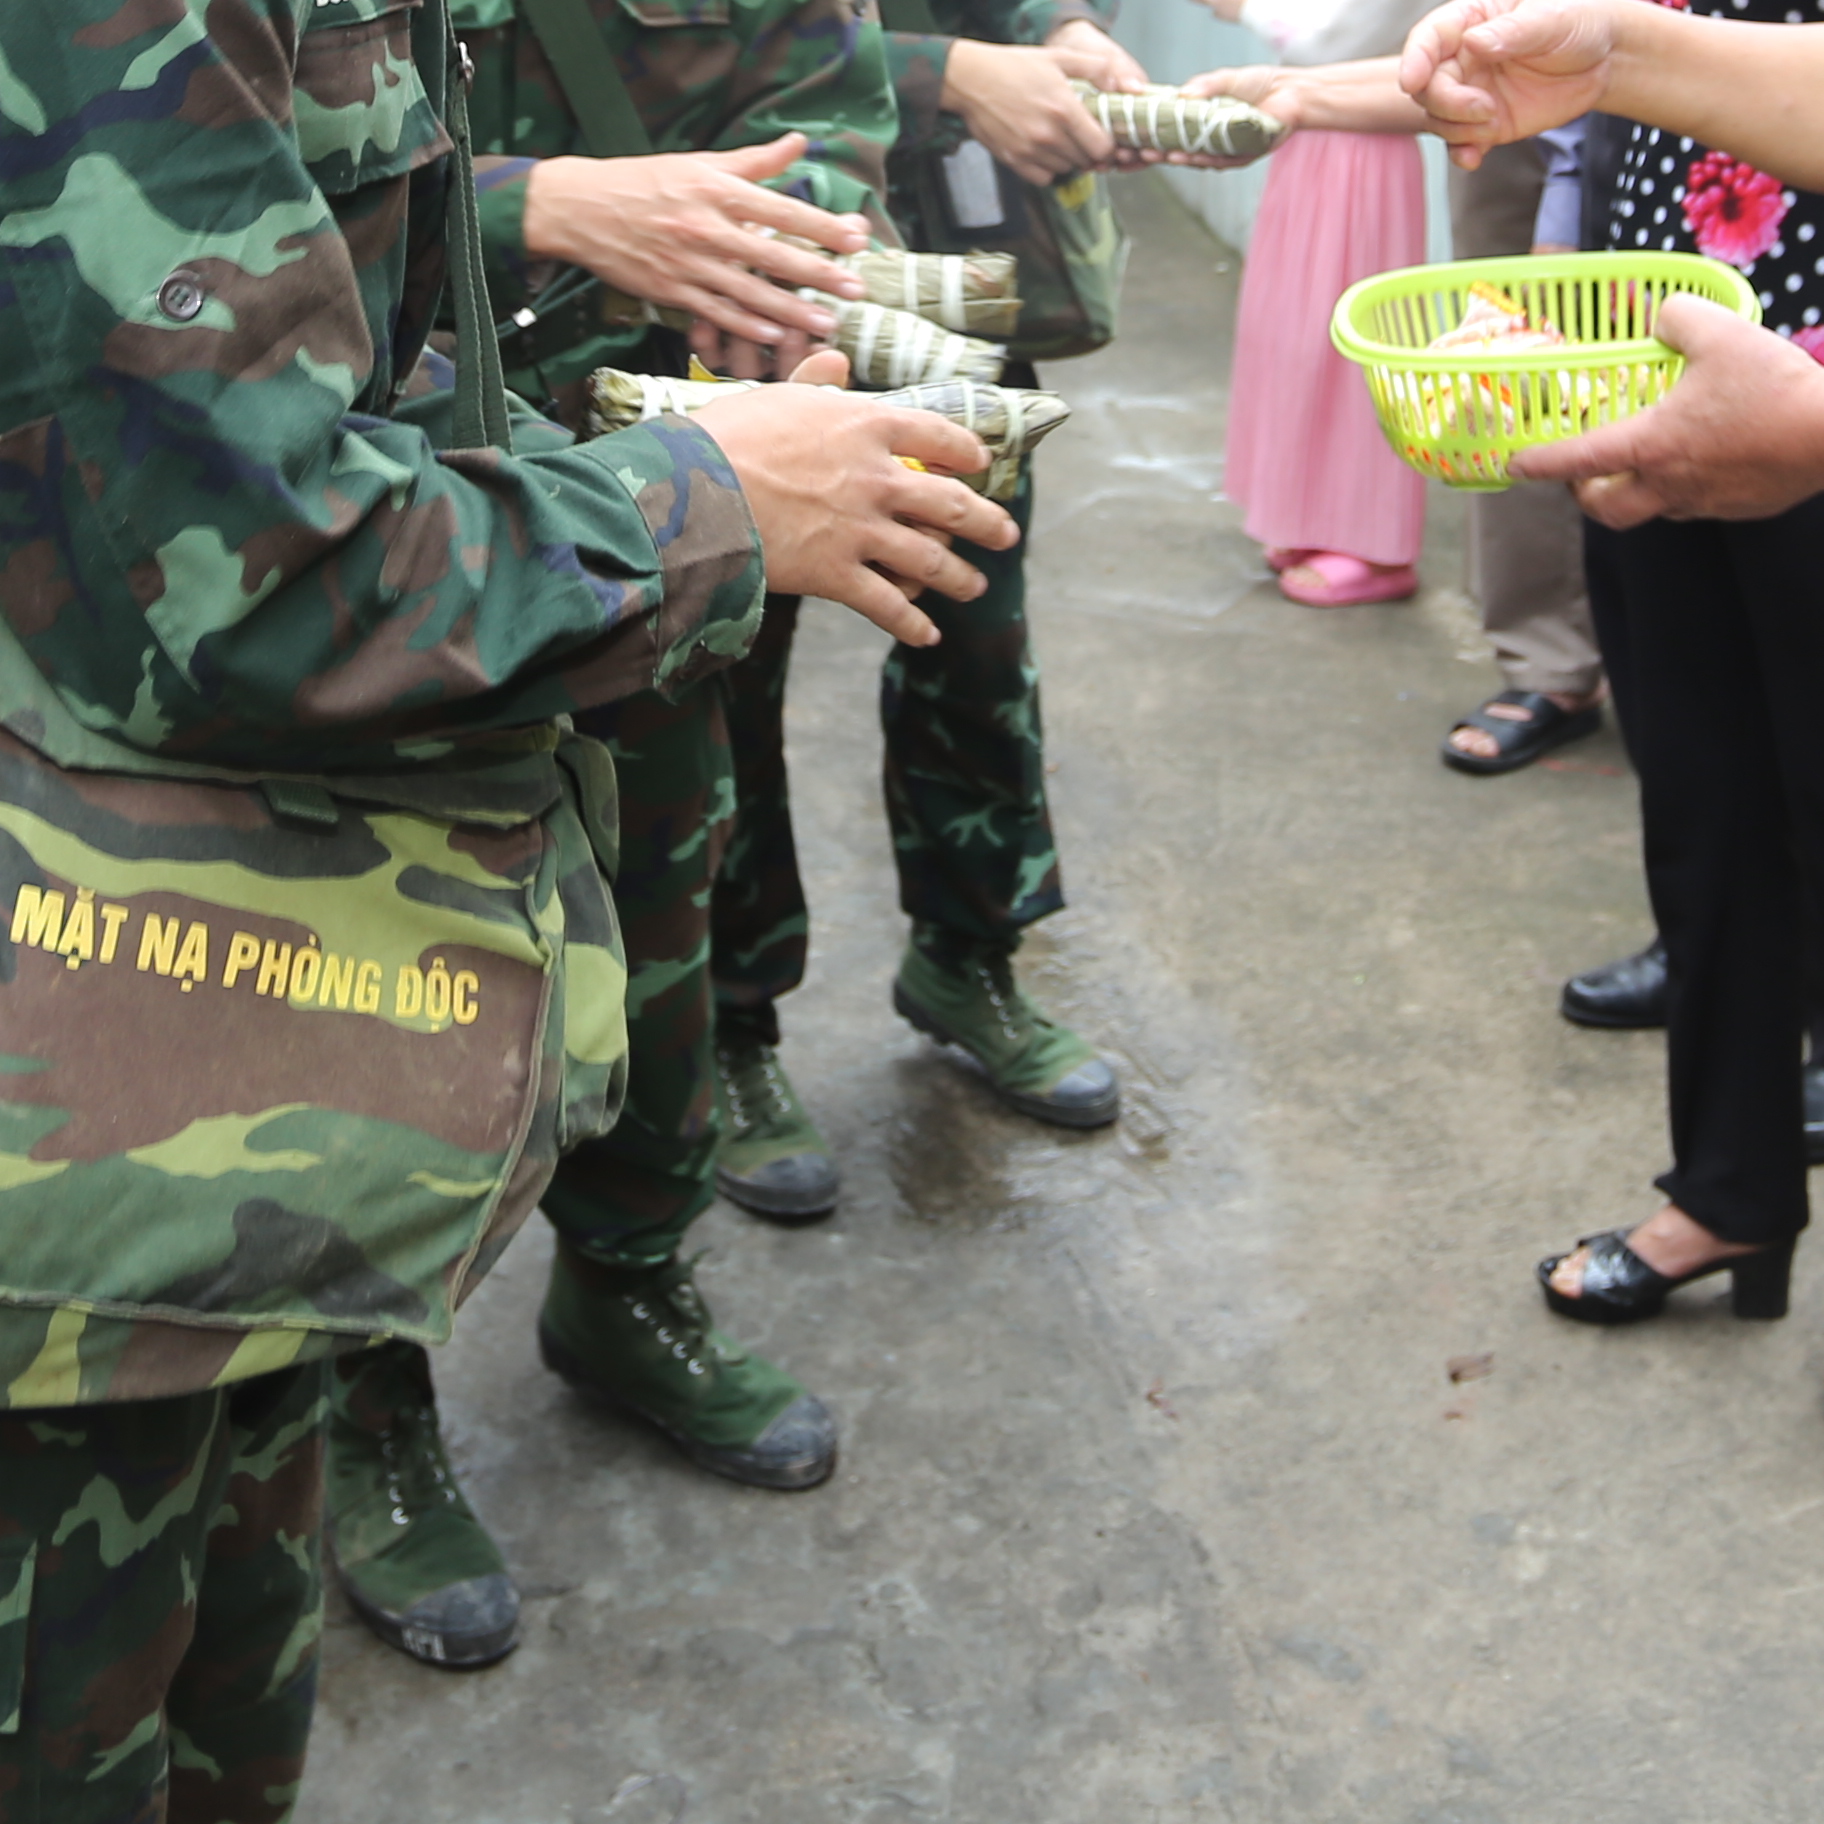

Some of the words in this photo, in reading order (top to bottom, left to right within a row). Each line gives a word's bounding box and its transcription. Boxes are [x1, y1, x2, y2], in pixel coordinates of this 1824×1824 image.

[10, 884, 129, 971] MẶT
[137, 912, 209, 993] NẠ
[222, 931, 382, 1014] PHÒNG
[395, 956, 480, 1033] ĐỘC
